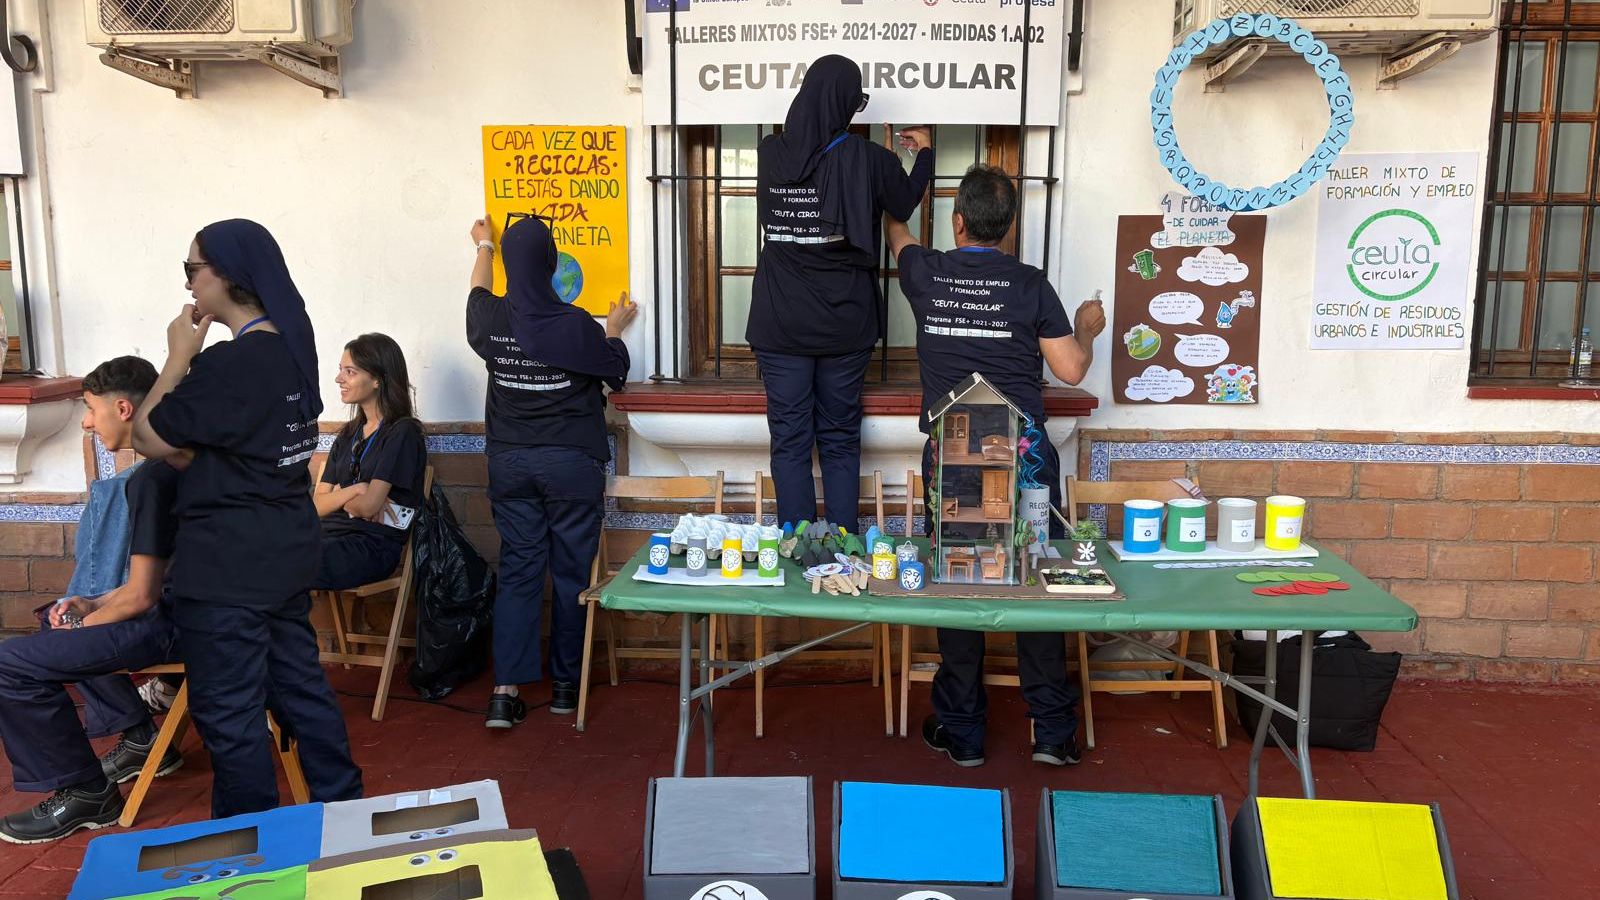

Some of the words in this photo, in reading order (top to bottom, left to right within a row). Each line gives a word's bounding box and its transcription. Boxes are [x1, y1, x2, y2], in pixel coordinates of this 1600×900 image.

[741, 23, 797, 42] MIXTOS
[801, 23, 836, 40] FSE+
[842, 22, 917, 41] 2021-2027
[930, 23, 996, 42] MEDIDAS
[698, 63, 807, 92] CEUTA
[862, 62, 1017, 90] IRCULAR
[492, 131, 534, 150] CADA
[542, 131, 576, 150] VEZ
[581, 131, 617, 152] QUE
[514, 154, 612, 176] RECICLAS
[1328, 166, 1368, 180] TALLER
[1384, 167, 1428, 180] MIXTO
[1441, 166, 1456, 178] DE
[493, 179, 514, 198] LE
[517, 178, 562, 198] ESTÁS
[570, 178, 620, 199] DANDO
[1327, 182, 1400, 200] FORMACIÓN
[1410, 186, 1420, 198] Y
[1426, 184, 1474, 198] EMPLEO
[1161, 194, 1172, 212] 4
[553, 226, 612, 246] ANETA
[1180, 230, 1230, 246] PLANETA
[1351, 237, 1430, 266] ceuta
[1362, 268, 1419, 280] circular
[954, 288, 990, 296] FORMACIÓN
[1316, 301, 1370, 318] GESTIÓN
[1374, 307, 1391, 318] DE
[1400, 305, 1461, 320] RESIDUOS
[926, 316, 952, 324] Programa
[972, 320, 1008, 328] 2021-2027
[1314, 324, 1366, 338] URBANOS
[1371, 324, 1379, 337] E
[1388, 322, 1464, 338] INDUSTRIALES
